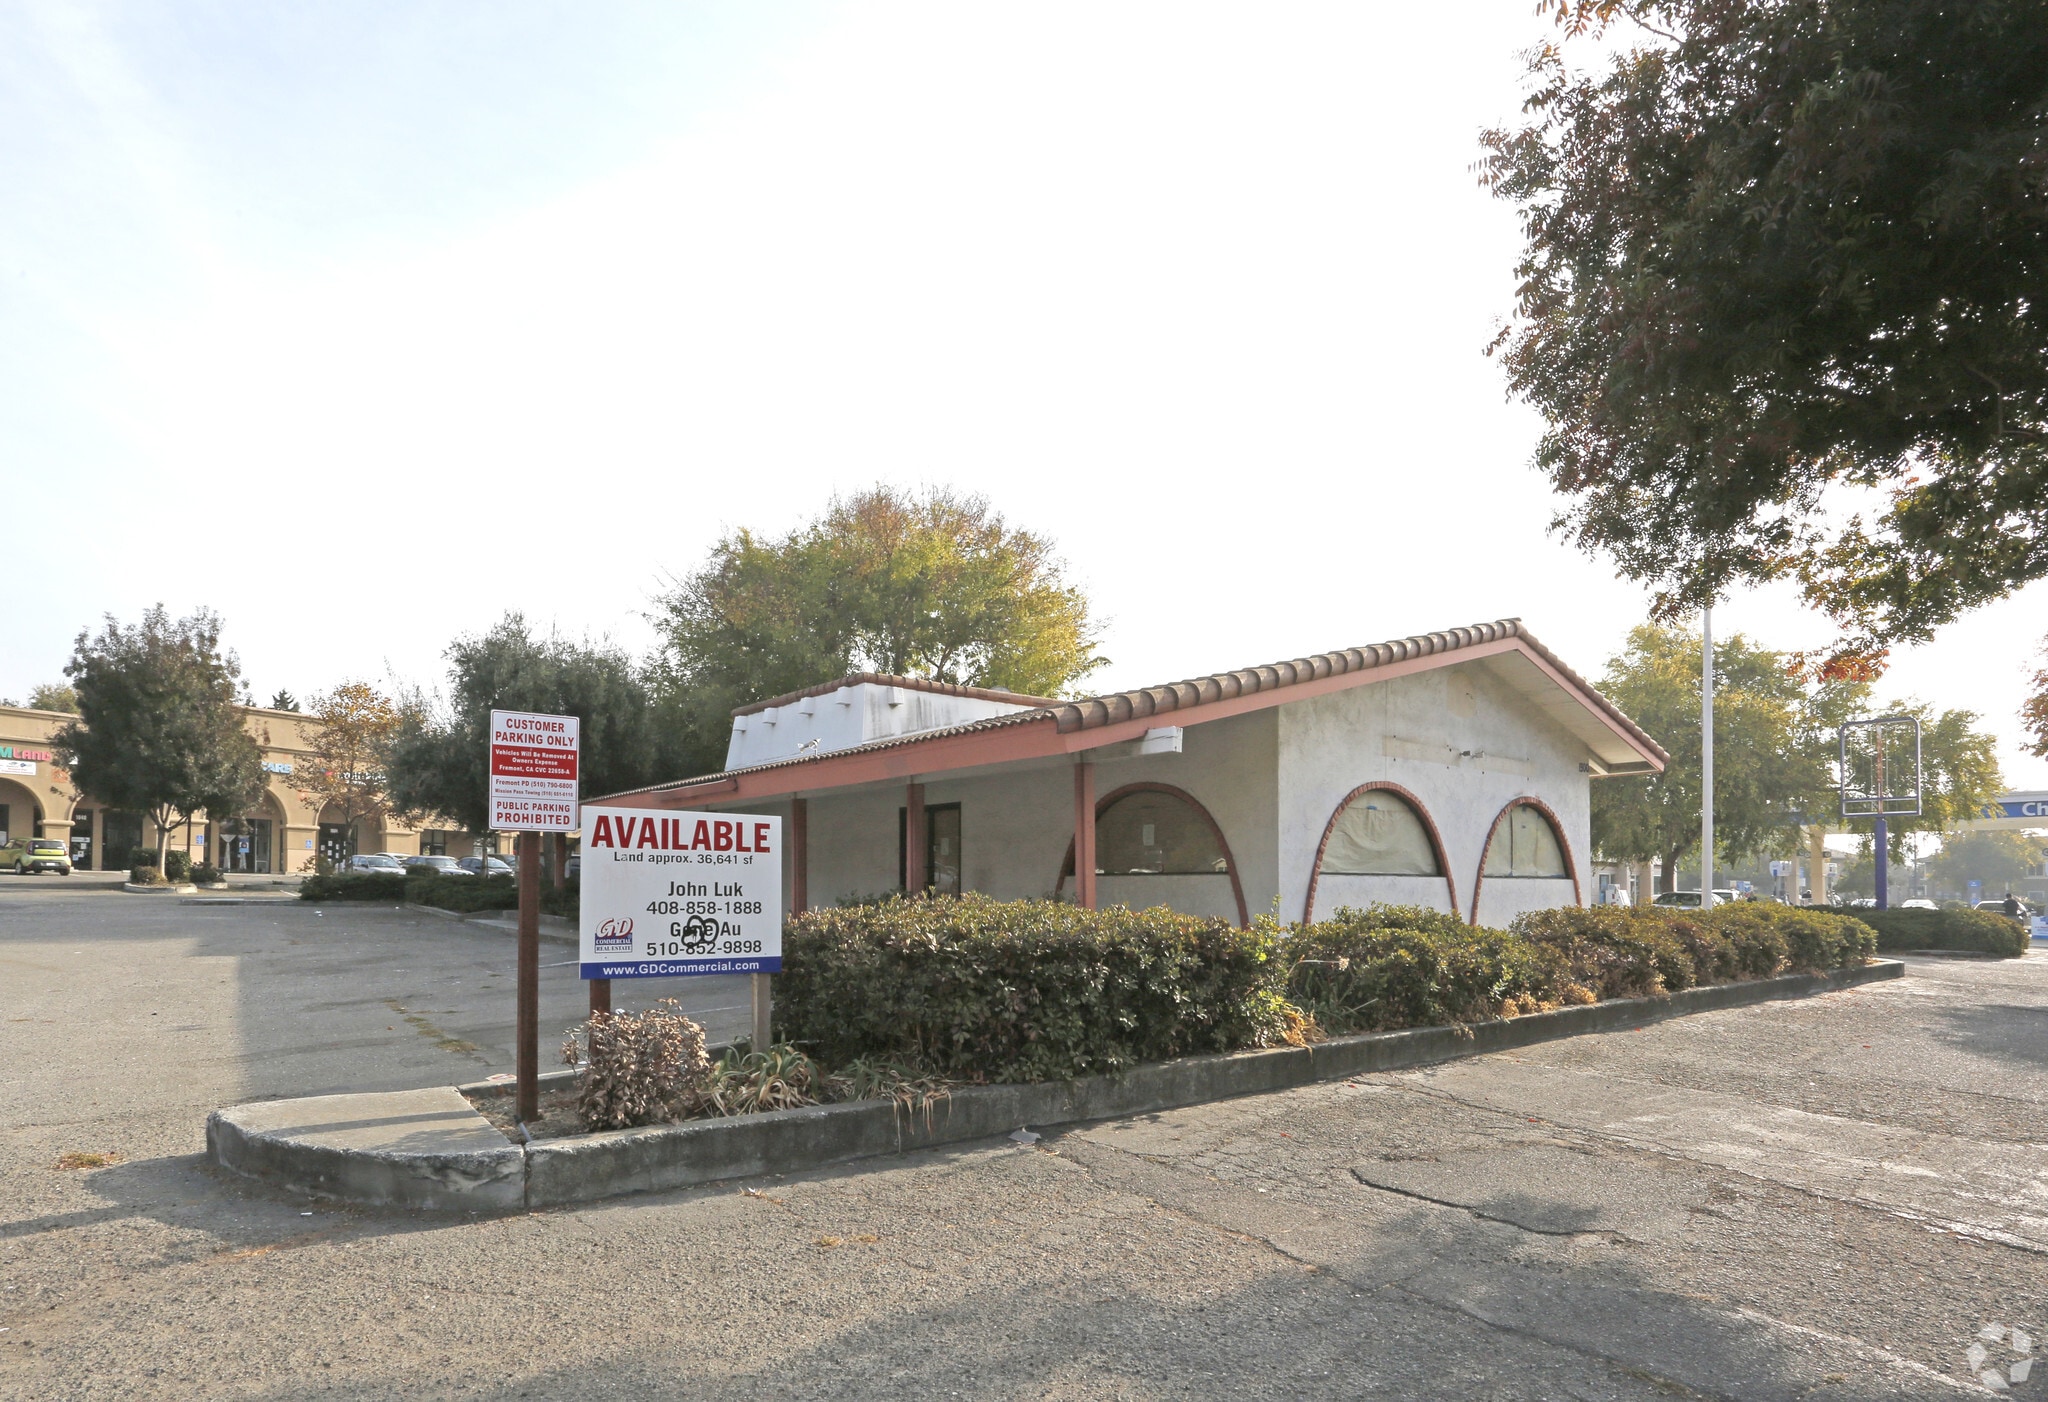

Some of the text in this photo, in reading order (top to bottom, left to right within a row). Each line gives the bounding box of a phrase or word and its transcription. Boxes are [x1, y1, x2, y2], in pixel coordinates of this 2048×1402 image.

[506, 718, 564, 733] CUSTOMER
[496, 731, 574, 747] PARKING ONLY
[497, 802, 570, 812] PUBLIC PARKING
[497, 812, 570, 825] PROHIBITED
[591, 815, 771, 853] AVAILABLE
[614, 851, 754, 865] Land approx. 36,641 sf
[668, 881, 744, 897] John Luk
[646, 901, 762, 914] 408-858-1888
[596, 917, 633, 938] GD
[721, 922, 741, 936] Au
[647, 940, 762, 956] 510-852-9898
[603, 962, 759, 975] www.GDCommercial.com
